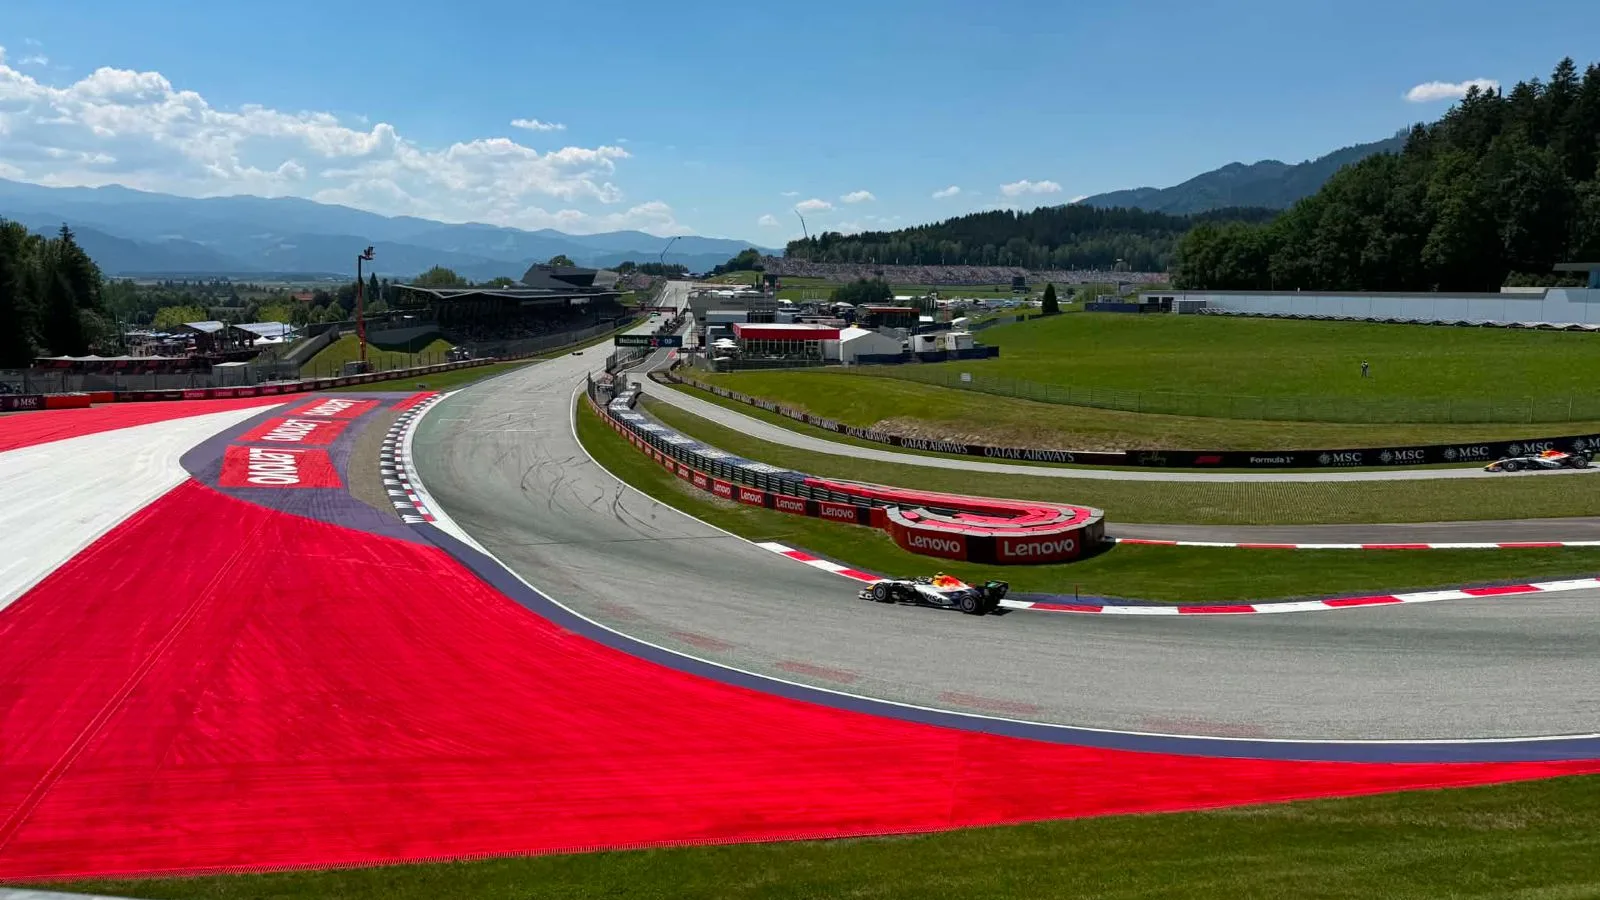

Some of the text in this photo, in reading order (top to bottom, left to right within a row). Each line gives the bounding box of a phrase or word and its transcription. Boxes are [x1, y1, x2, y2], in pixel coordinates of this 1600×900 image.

[20, 398, 38, 407] MSC
[901, 438, 968, 454] QATAR AIRWAYS
[1459, 446, 1489, 457] MSC
[1523, 441, 1554, 454] MSC
[984, 447, 1075, 462] QATAR AIRWAYS
[1250, 456, 1285, 464] Formula
[1333, 452, 1362, 463] MSC
[1395, 449, 1425, 460] MSC
[247, 448, 306, 485] Lenovo
[714, 482, 731, 495] Lenovo
[740, 490, 762, 504] Lenovo
[776, 498, 804, 511] Lenovo
[821, 506, 854, 519] Lenovo
[906, 531, 961, 553] Lenovo
[1004, 538, 1074, 556] Lenovo
[925, 593, 942, 604] VISA
